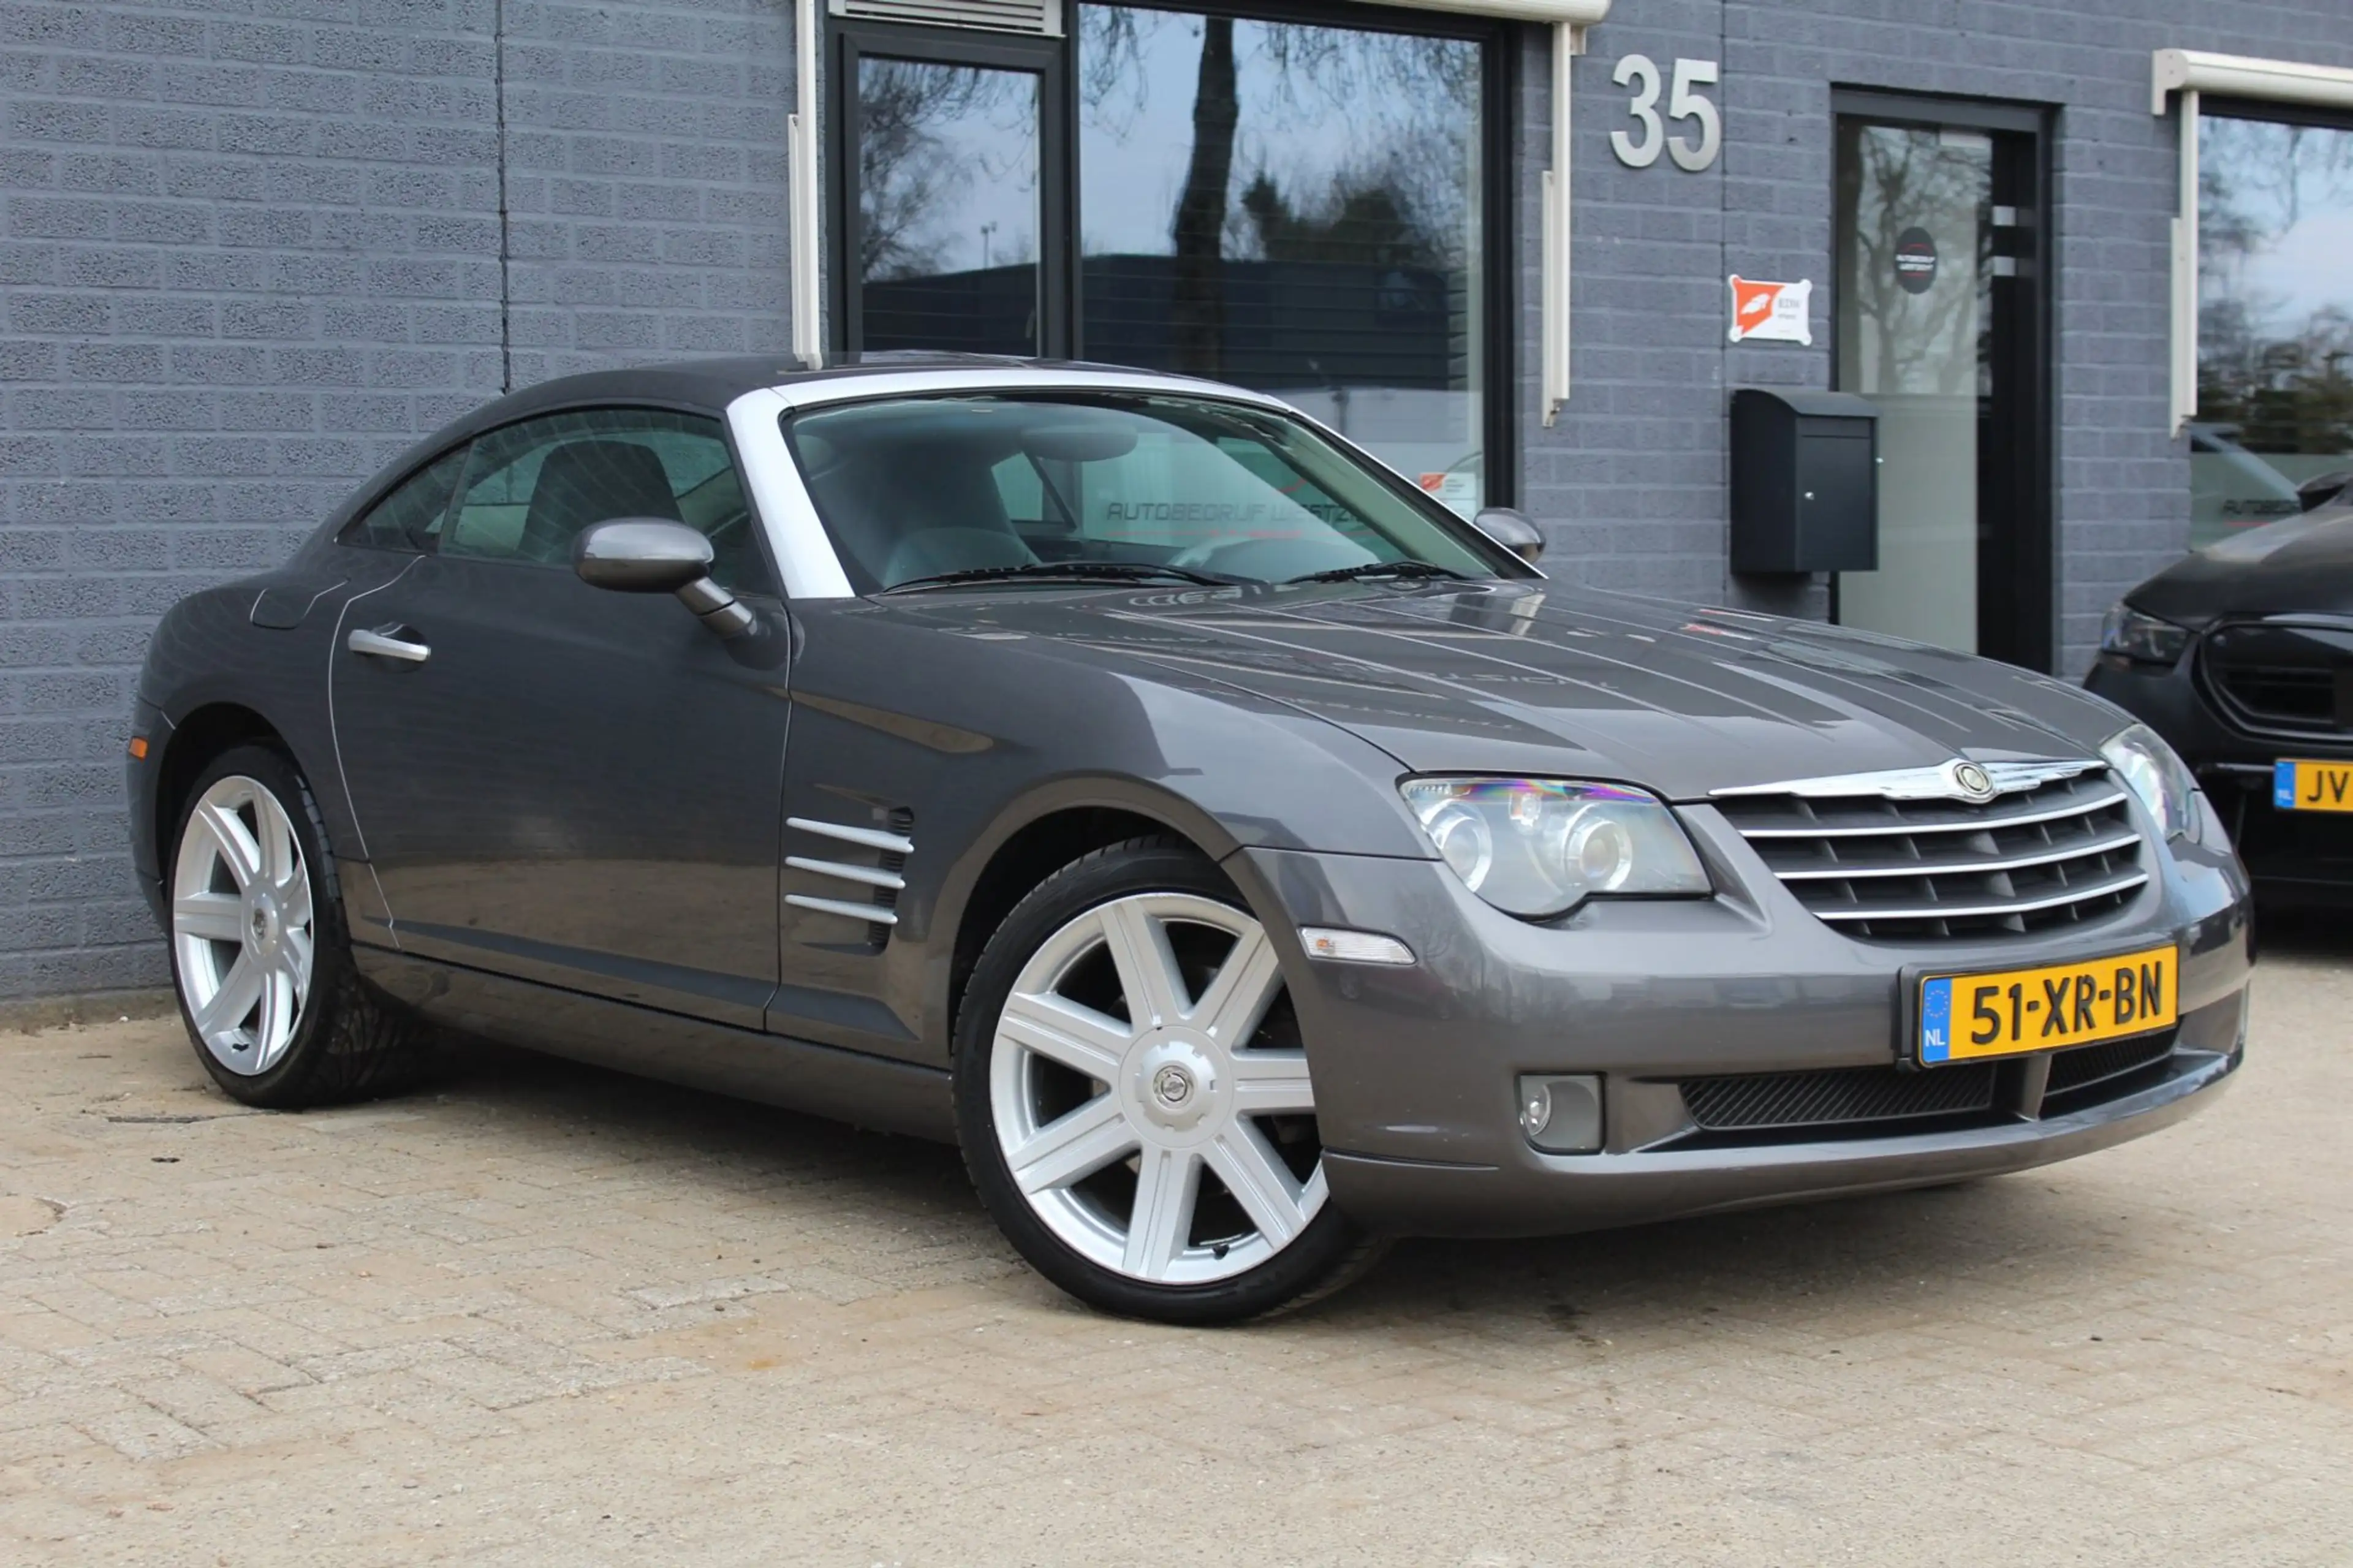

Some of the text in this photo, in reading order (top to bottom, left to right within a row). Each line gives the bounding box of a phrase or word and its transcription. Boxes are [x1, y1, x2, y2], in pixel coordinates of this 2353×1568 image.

[1610, 53, 1721, 172] 35
[1925, 1029, 1946, 1047] NL
[1971, 961, 2162, 1045] 51-XR-BN
